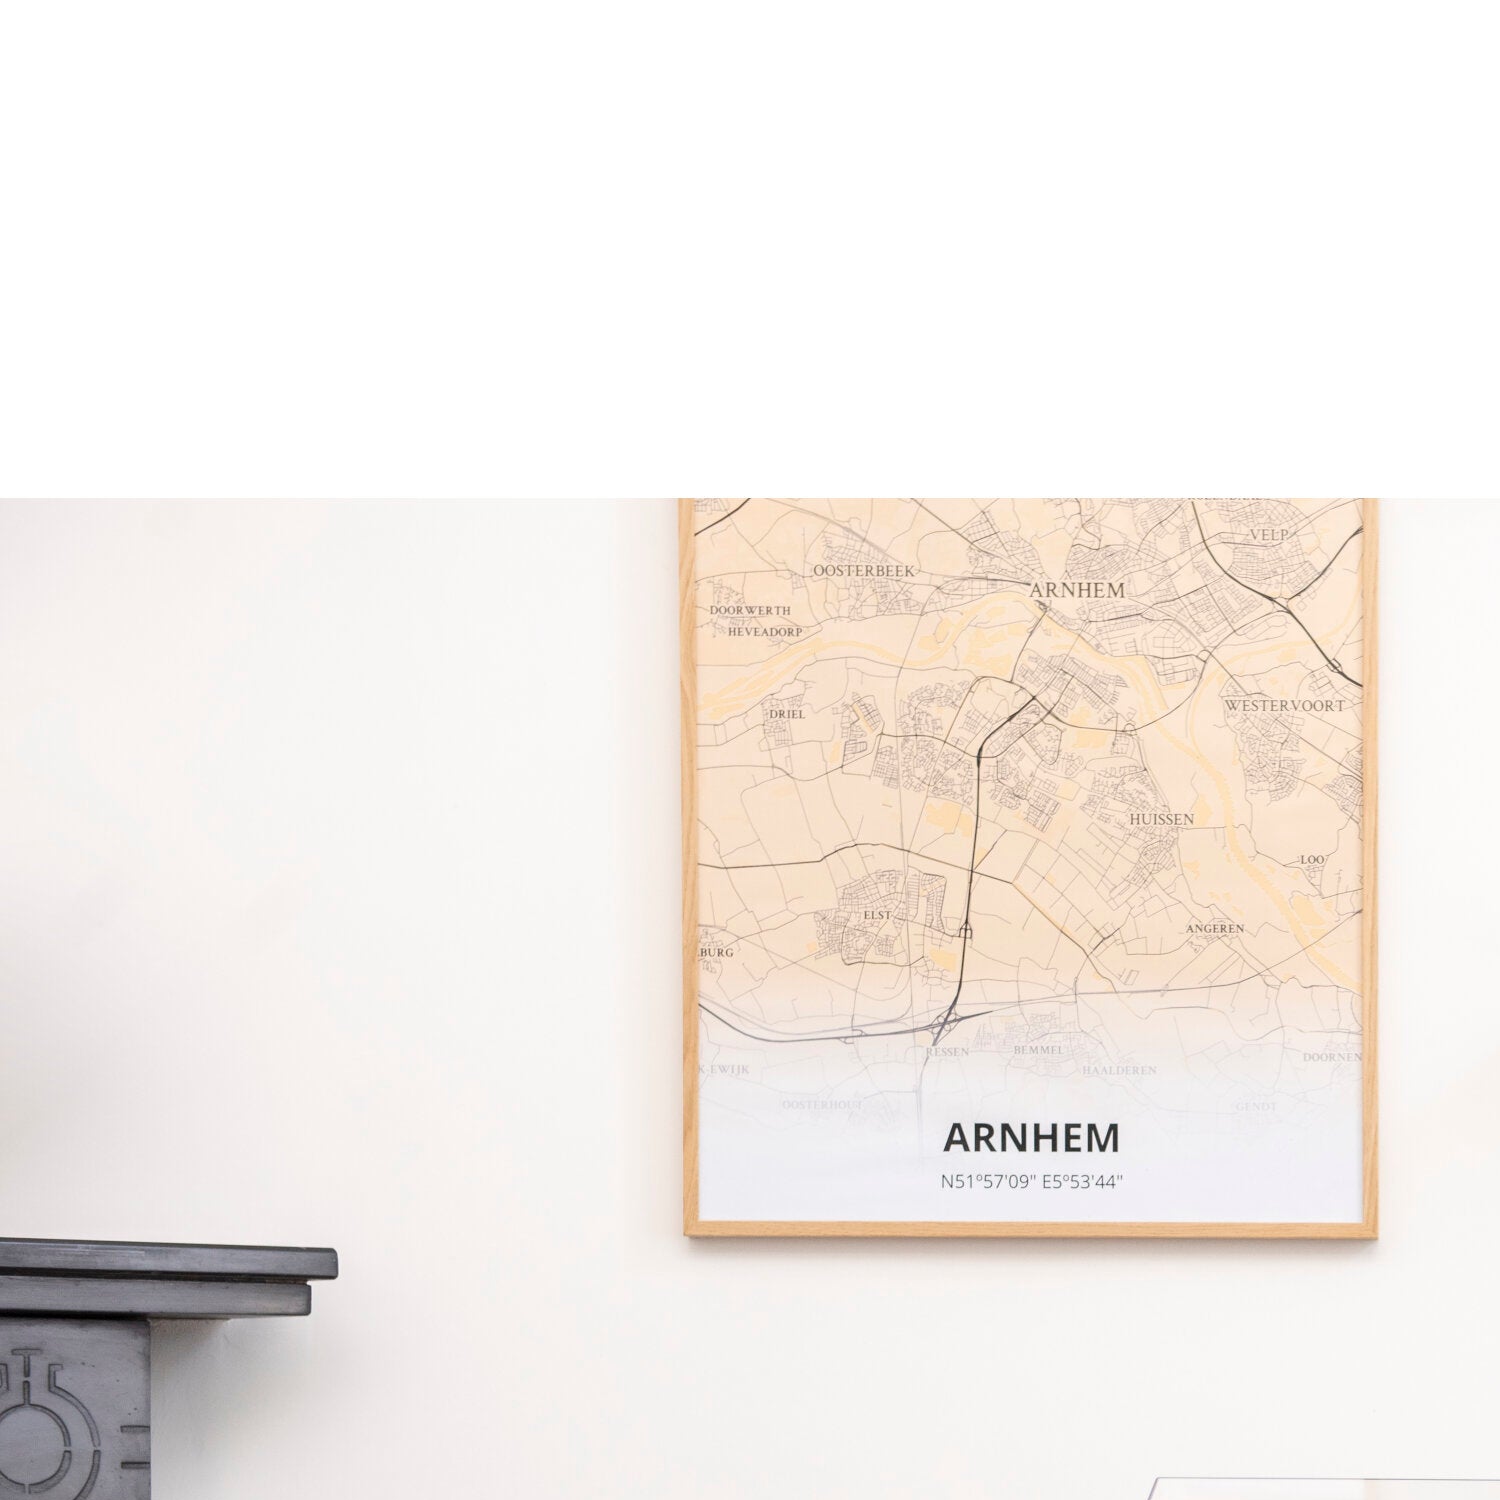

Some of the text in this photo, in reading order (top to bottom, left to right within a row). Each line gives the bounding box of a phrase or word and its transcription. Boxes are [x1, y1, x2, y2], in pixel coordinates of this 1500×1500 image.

[1249, 528, 1289, 541] VELP
[813, 564, 915, 577] OOSTERBEEK
[1029, 582, 1125, 598] ARNHEM
[710, 605, 791, 616] DOORWERTH
[728, 627, 803, 637] HEVEADORP
[1225, 699, 1346, 712] WESTERVOORT
[770, 709, 806, 719] DRIEL
[1129, 813, 1195, 826] HUISSEN
[1300, 855, 1325, 865] LOO
[864, 910, 892, 920] ELST
[1186, 924, 1245, 934] ANGEREN
[698, 948, 734, 958] BURG
[926, 1047, 970, 1057] RESSEN
[1014, 1045, 1065, 1055] BEMMEL
[1082, 1065, 1157, 1075] HAALDEREN
[782, 1100, 863, 1110] OOSTERHOUT
[1236, 1102, 1277, 1112] GENDT
[943, 1122, 1119, 1153] ARNHEM
